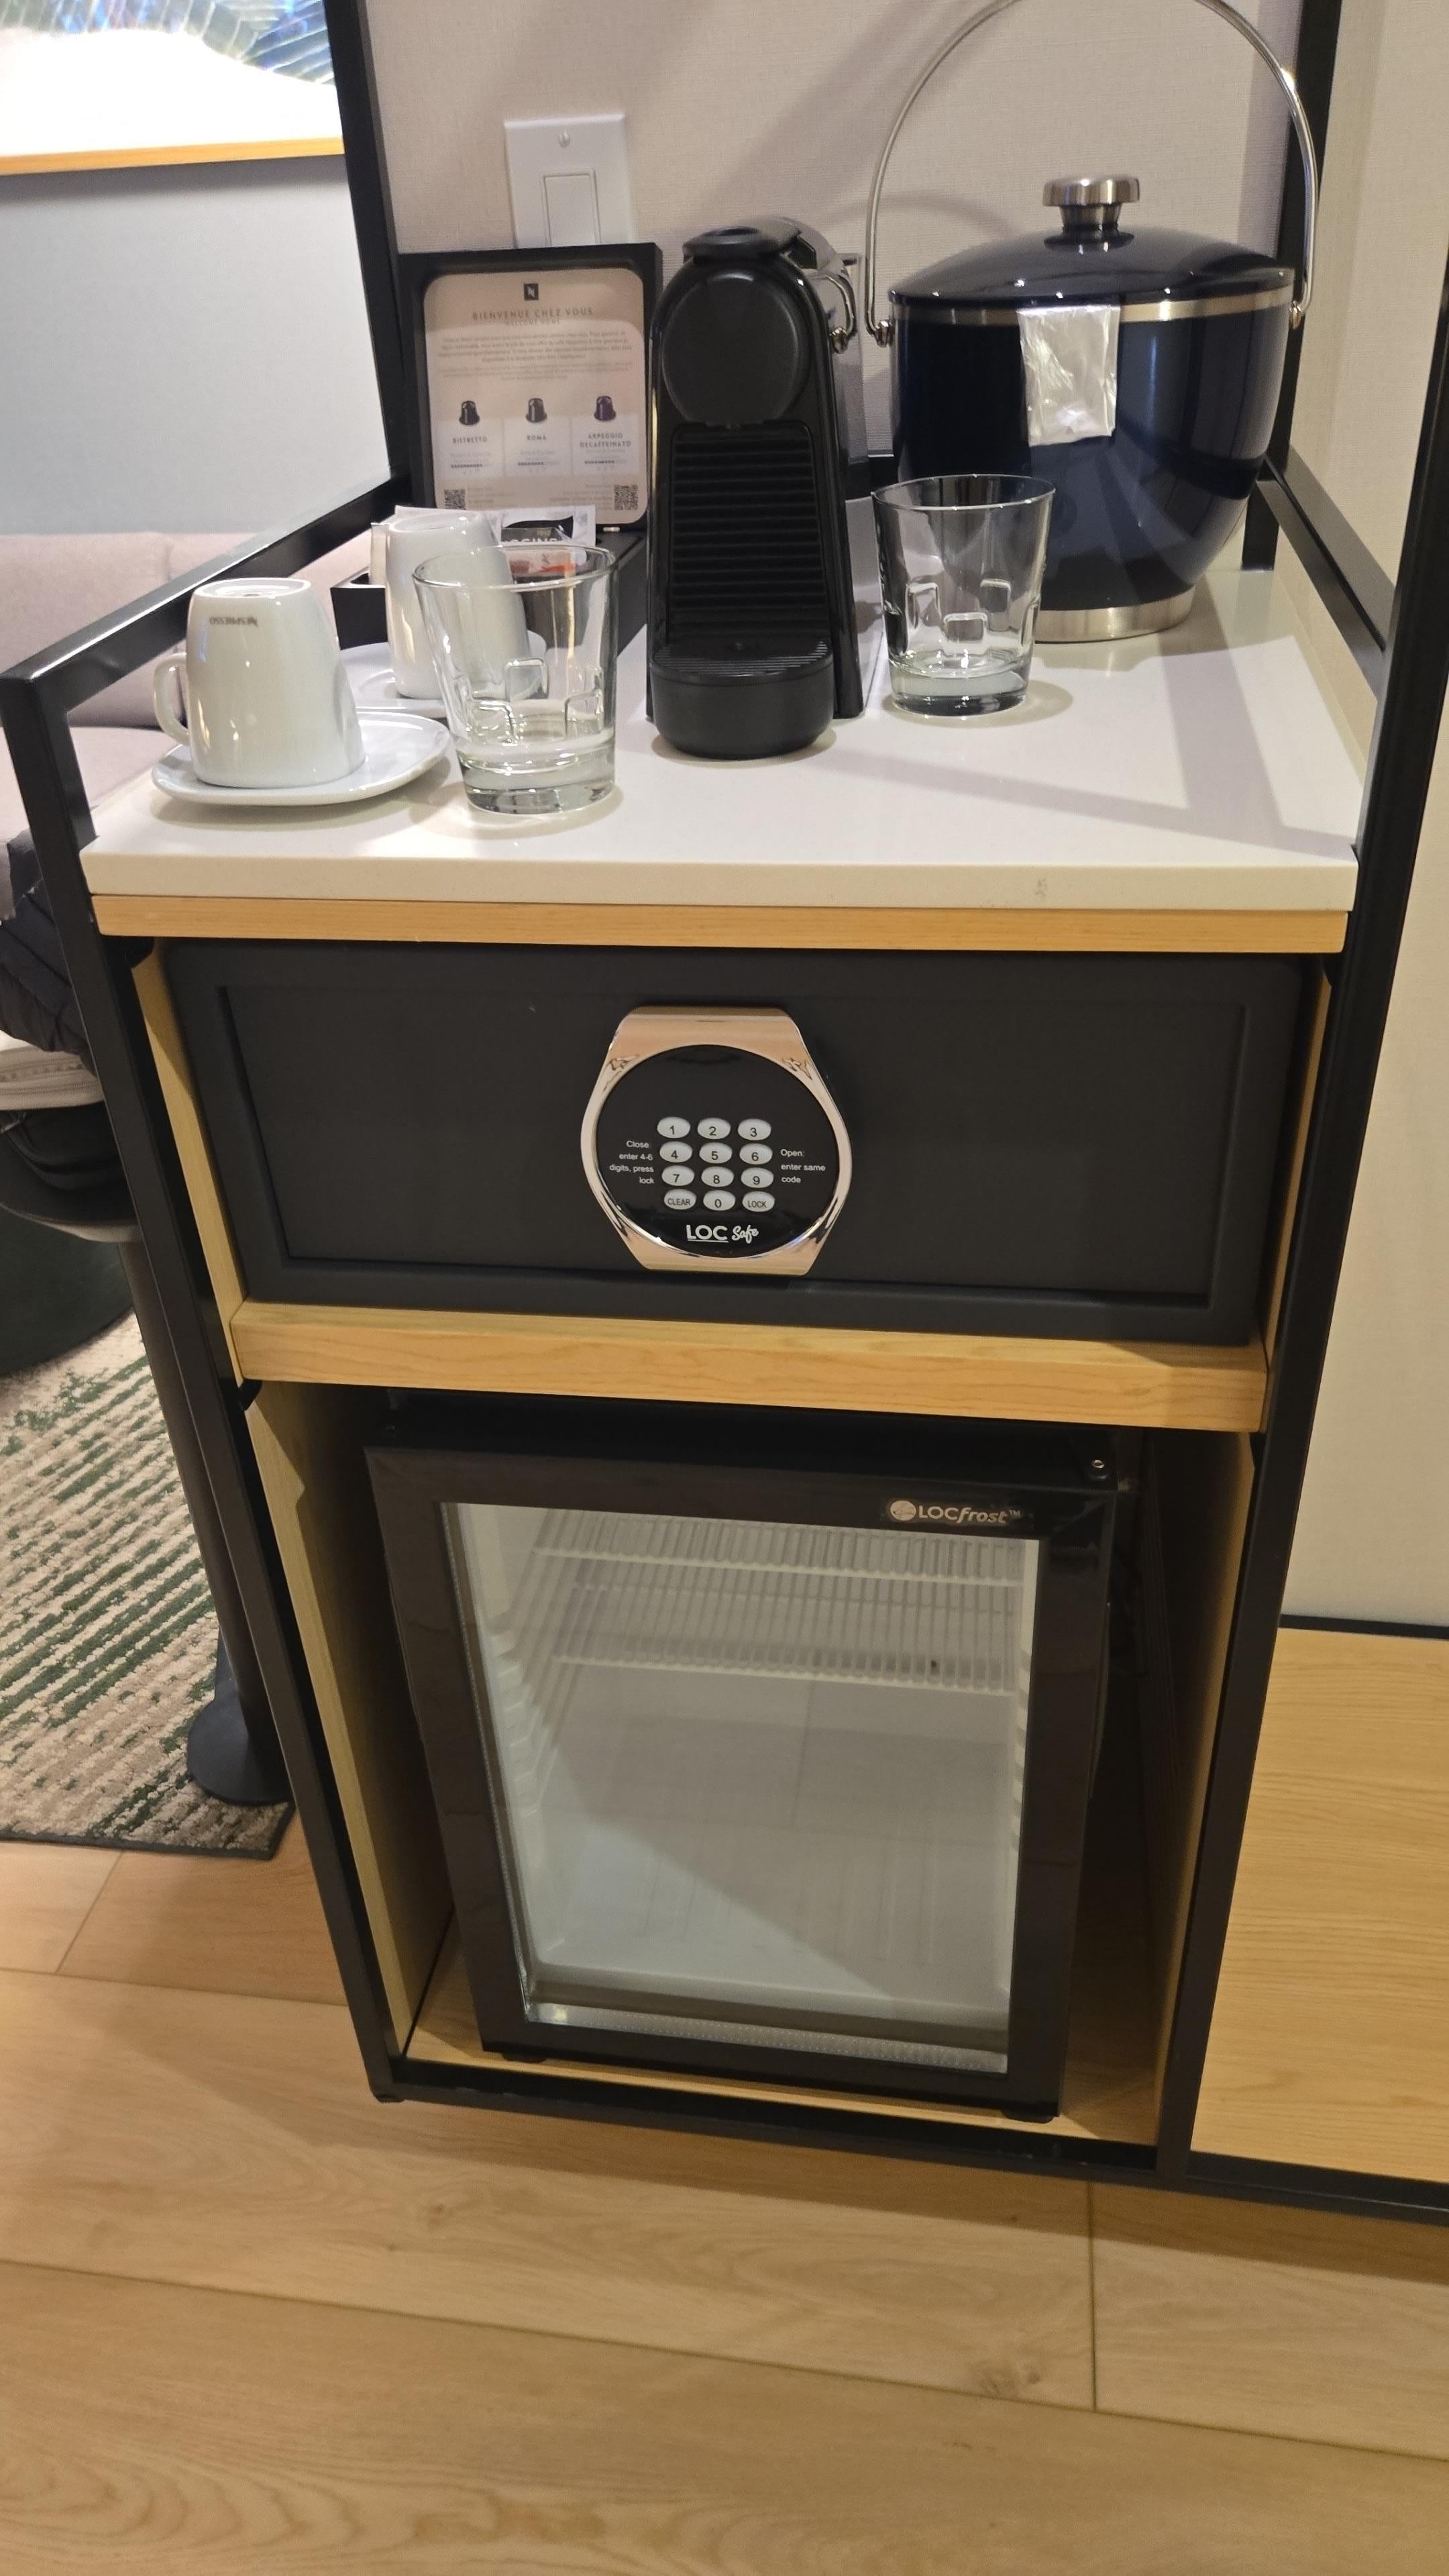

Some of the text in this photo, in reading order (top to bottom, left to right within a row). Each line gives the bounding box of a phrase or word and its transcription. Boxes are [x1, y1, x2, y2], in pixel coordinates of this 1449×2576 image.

[472, 306, 593, 321] BIENVENUE CHEZ VOUS
[669, 1126, 676, 1135] 1
[709, 1126, 717, 1136] 2
[750, 1127, 757, 1137] 3
[619, 1152, 653, 1161] enter 4-6
[671, 1150, 678, 1159] 4
[711, 1150, 718, 1161] 5
[751, 1151, 759, 1161] 6
[780, 1149, 804, 1159] Open:
[609, 1164, 655, 1174] digits, press
[639, 1177, 655, 1185] lock
[673, 1174, 680, 1183] 7
[713, 1175, 720, 1185] 8
[753, 1175, 761, 1185] 9
[782, 1175, 801, 1183] code
[667, 1198, 691, 1206] CLEAR
[714, 1198, 722, 1208] 0
[747, 1200, 767, 1208] LOCK
[686, 1224, 759, 1244] LOC Safe
